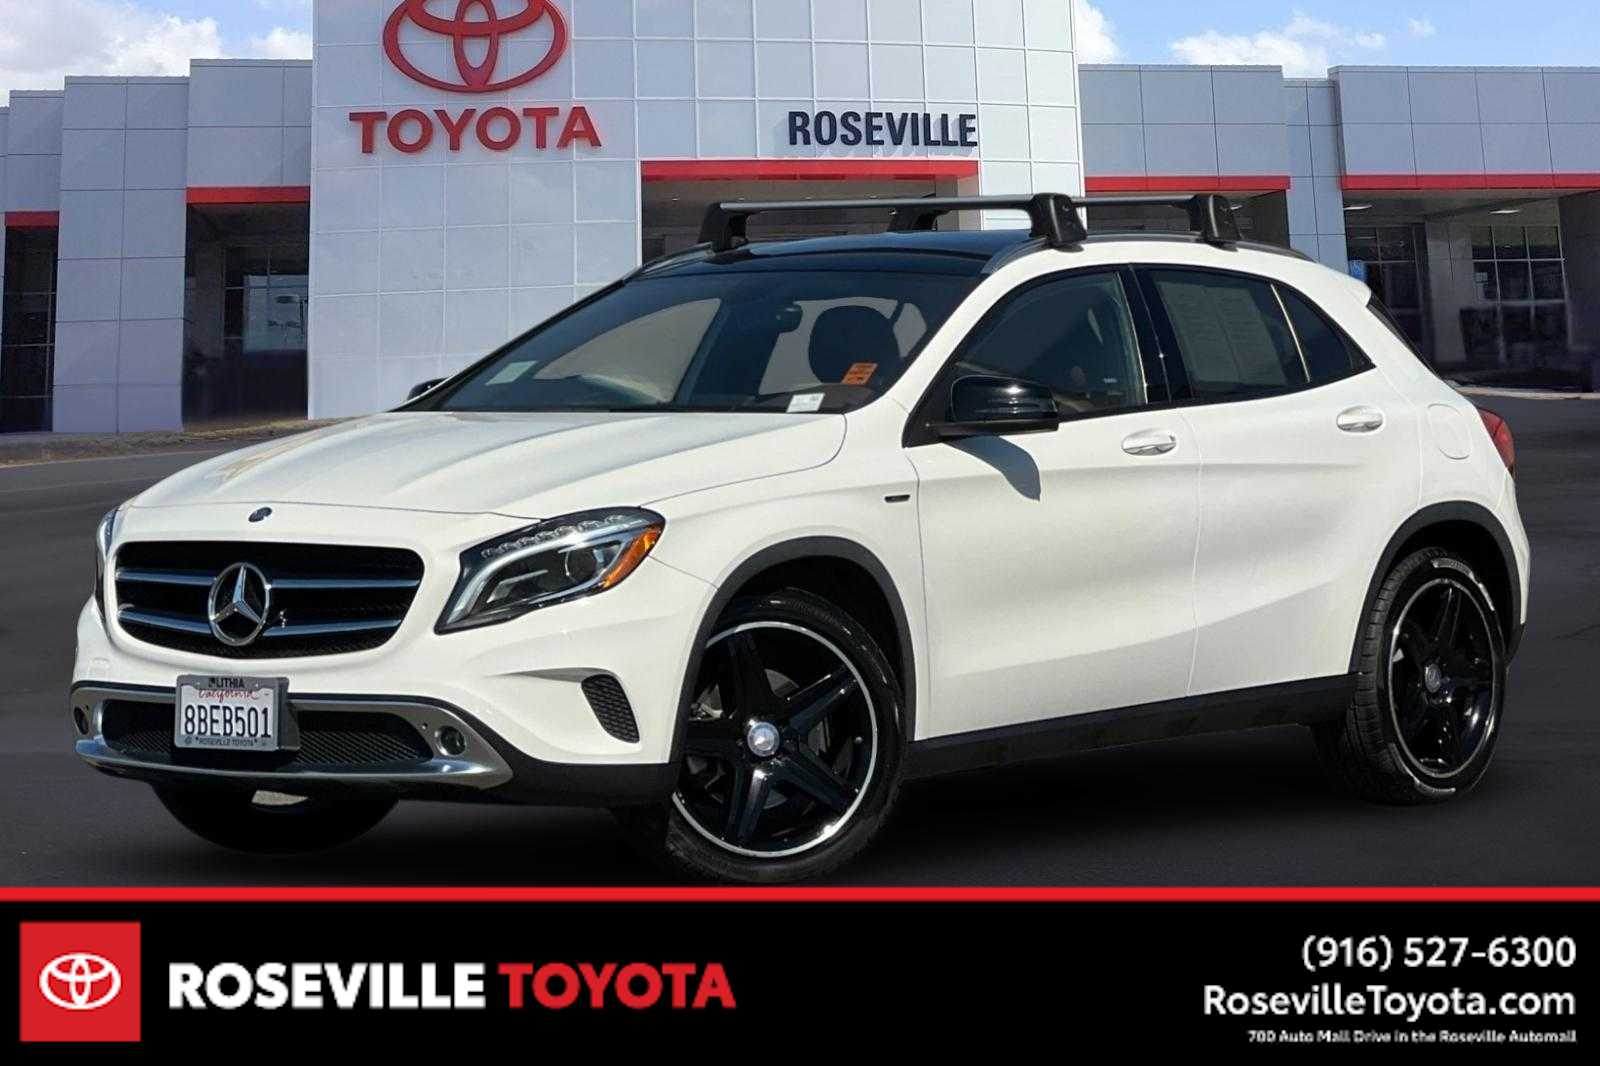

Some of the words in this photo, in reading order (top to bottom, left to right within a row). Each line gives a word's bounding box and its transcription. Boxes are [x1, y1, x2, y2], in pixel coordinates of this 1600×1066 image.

[349, 106, 602, 154] TOYOTA
[788, 111, 978, 147] ROSEVILLE
[184, 704, 271, 738] 8BEB501
